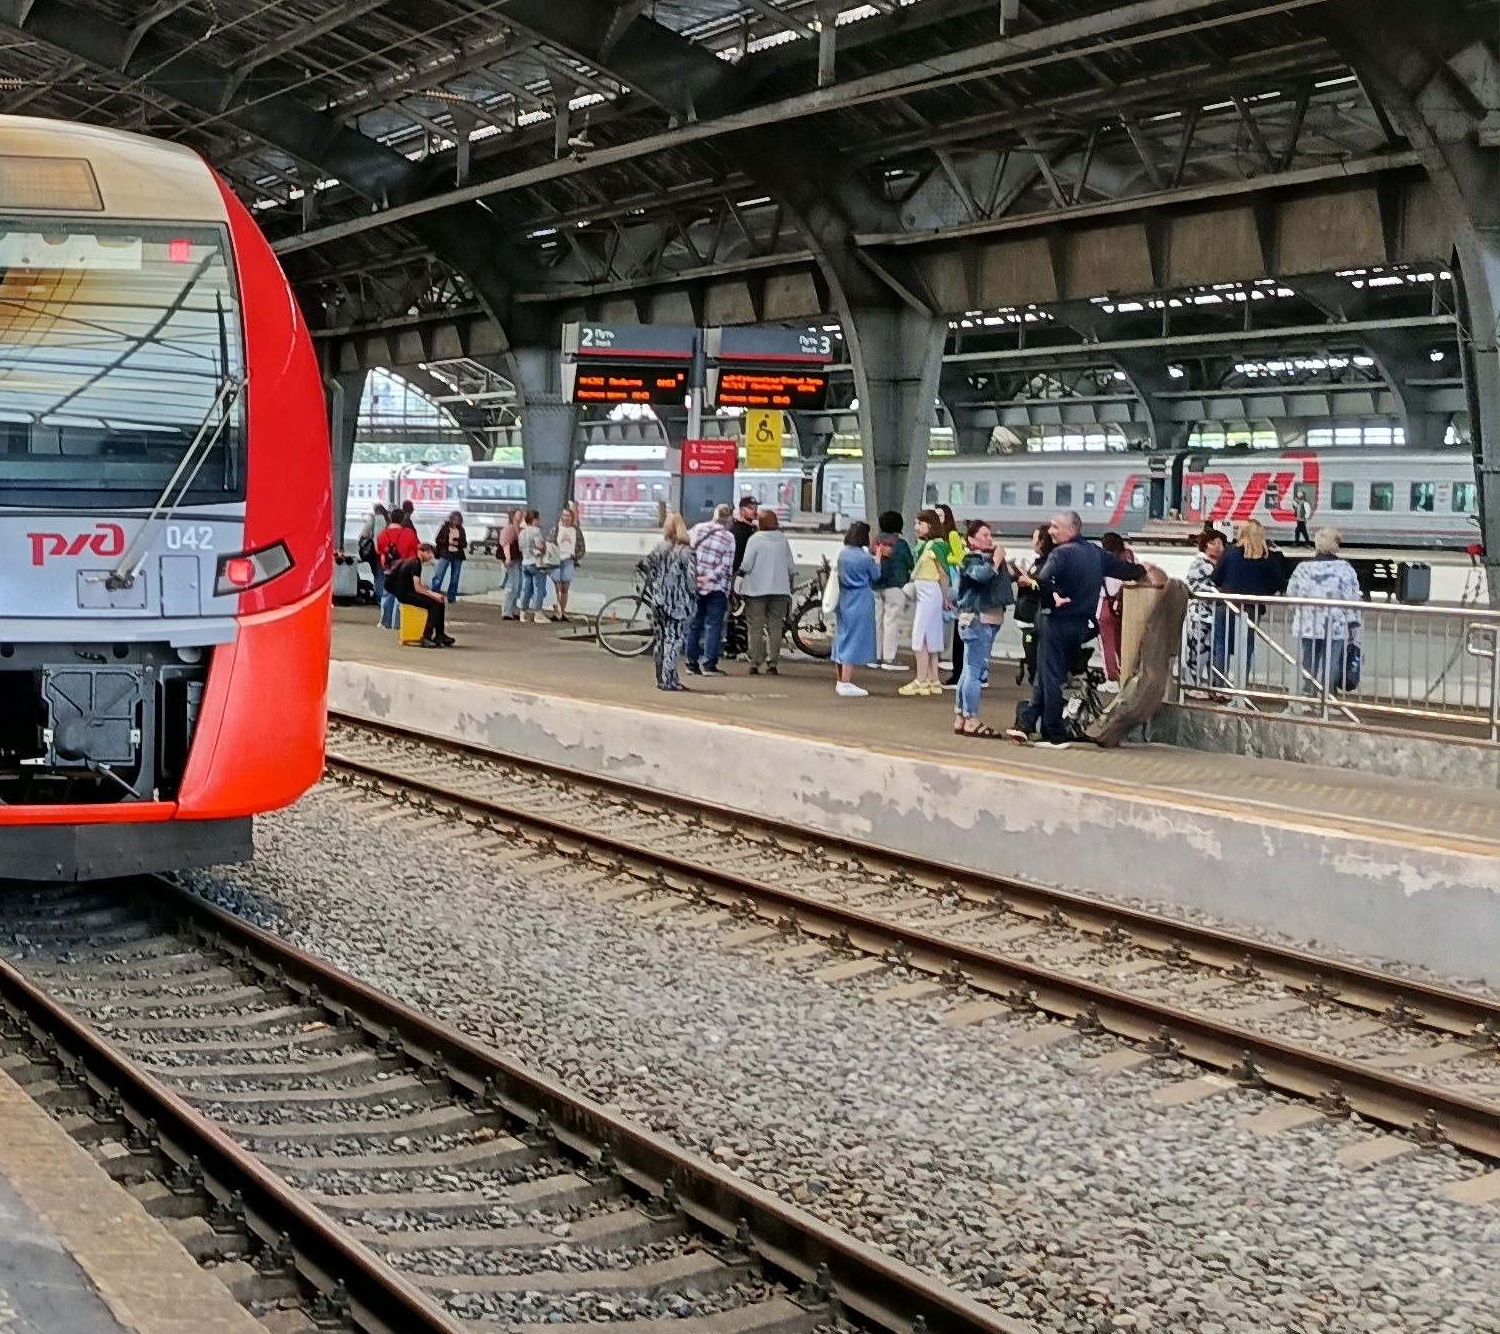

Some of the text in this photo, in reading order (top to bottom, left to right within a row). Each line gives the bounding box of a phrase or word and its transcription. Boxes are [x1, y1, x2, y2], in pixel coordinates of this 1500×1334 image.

[582, 328, 593, 346] 2
[819, 336, 830, 354] 3
[166, 525, 214, 550] 042
